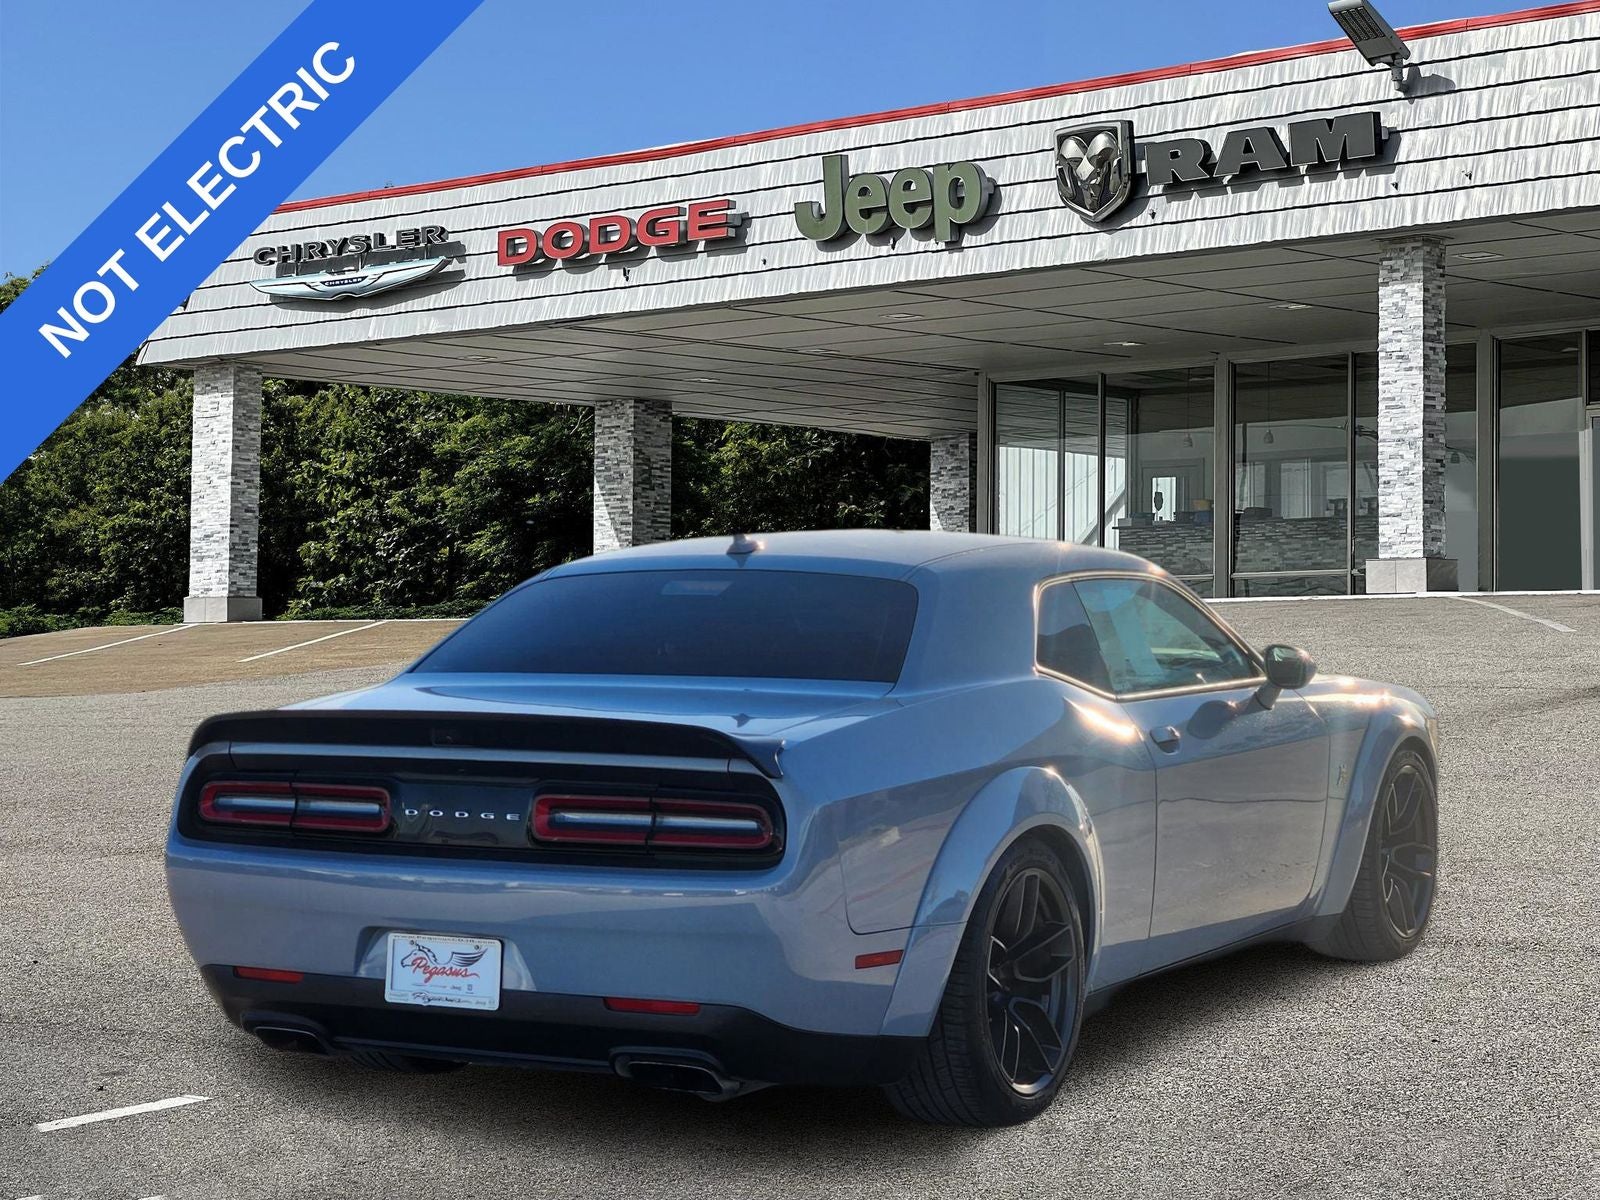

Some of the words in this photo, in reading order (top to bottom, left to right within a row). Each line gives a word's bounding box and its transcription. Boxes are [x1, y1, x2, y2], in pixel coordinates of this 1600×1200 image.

[1144, 111, 1381, 186] RAM
[795, 154, 990, 242] Jeep
[253, 224, 450, 267] CHRYSLER
[497, 199, 736, 267] DODGE
[404, 808, 521, 821] DODGE
[411, 956, 480, 984] Pegasus
